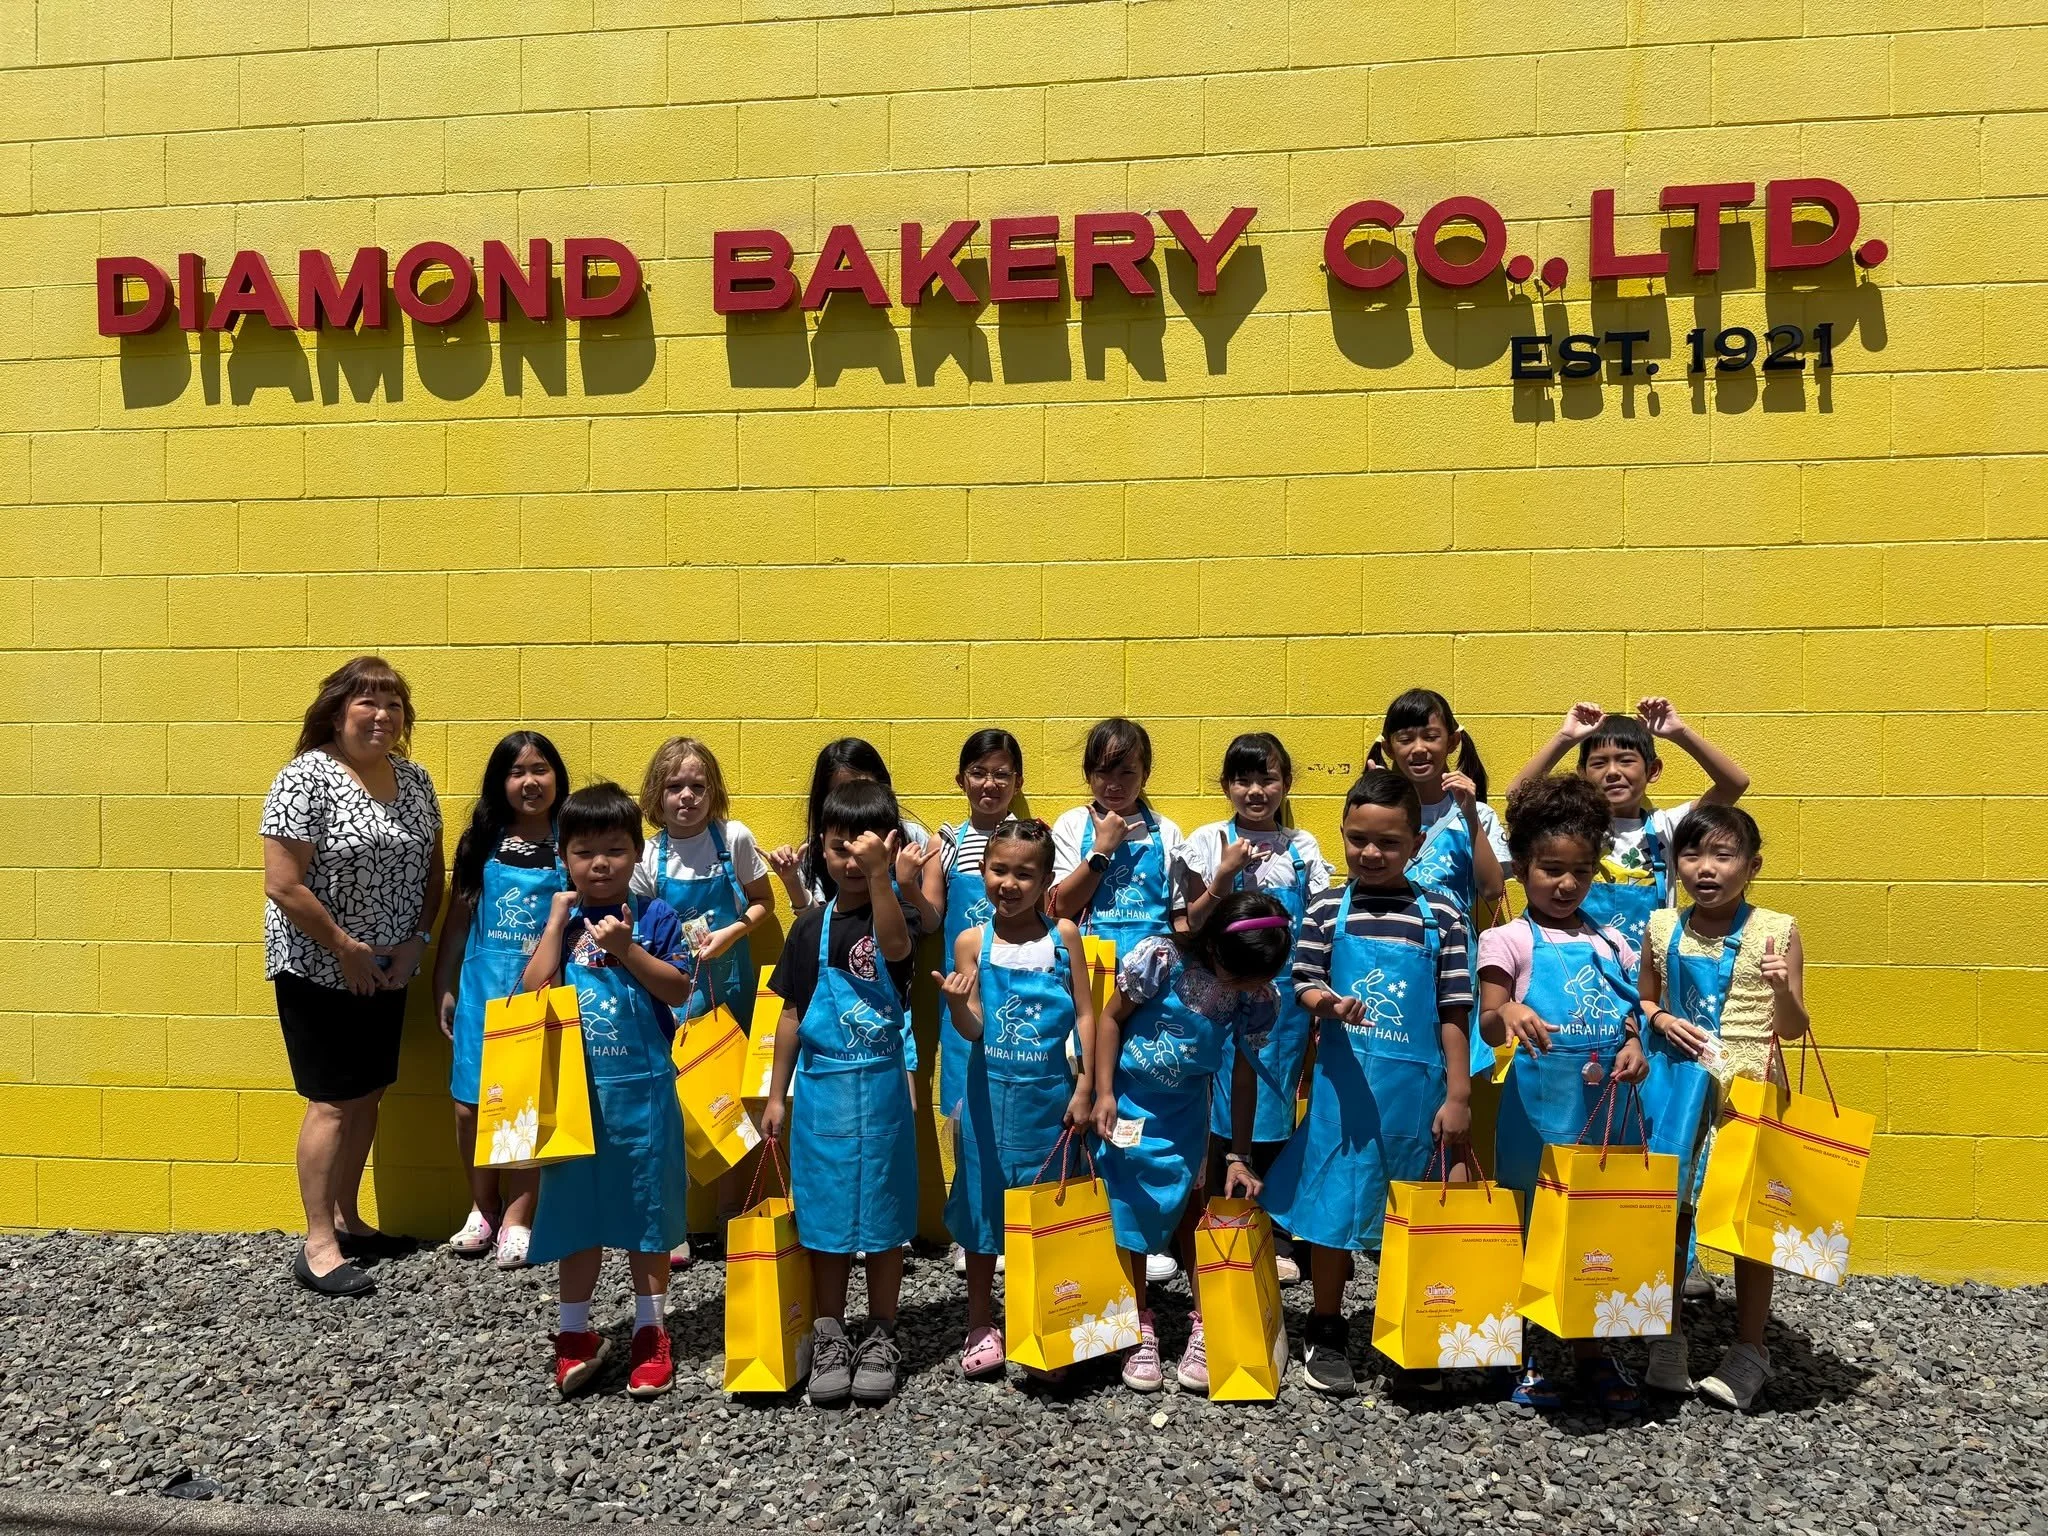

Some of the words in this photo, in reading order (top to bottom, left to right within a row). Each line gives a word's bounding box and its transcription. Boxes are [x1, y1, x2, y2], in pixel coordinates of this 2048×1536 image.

[96, 237, 644, 337] DIAMOND
[713, 206, 1258, 315] BAKERY
[1589, 177, 1889, 281] LTD.
[1510, 330, 1660, 380] EST.
[1686, 321, 1834, 374] 1921
[1096, 908, 1124, 918] MIRAI
[1126, 909, 1152, 920] HANA
[487, 929, 512, 940] MIRAI
[514, 932, 542, 941] HANA
[1374, 1027, 1410, 1044] HANA
[1560, 1023, 1596, 1036] MIRAI
[592, 1045, 629, 1057] HANA
[984, 1044, 1014, 1060] MIRAI
[1017, 1051, 1049, 1062] HANA
[1128, 1039, 1151, 1071] MIRAI
[1150, 1067, 1180, 1088] HANA
